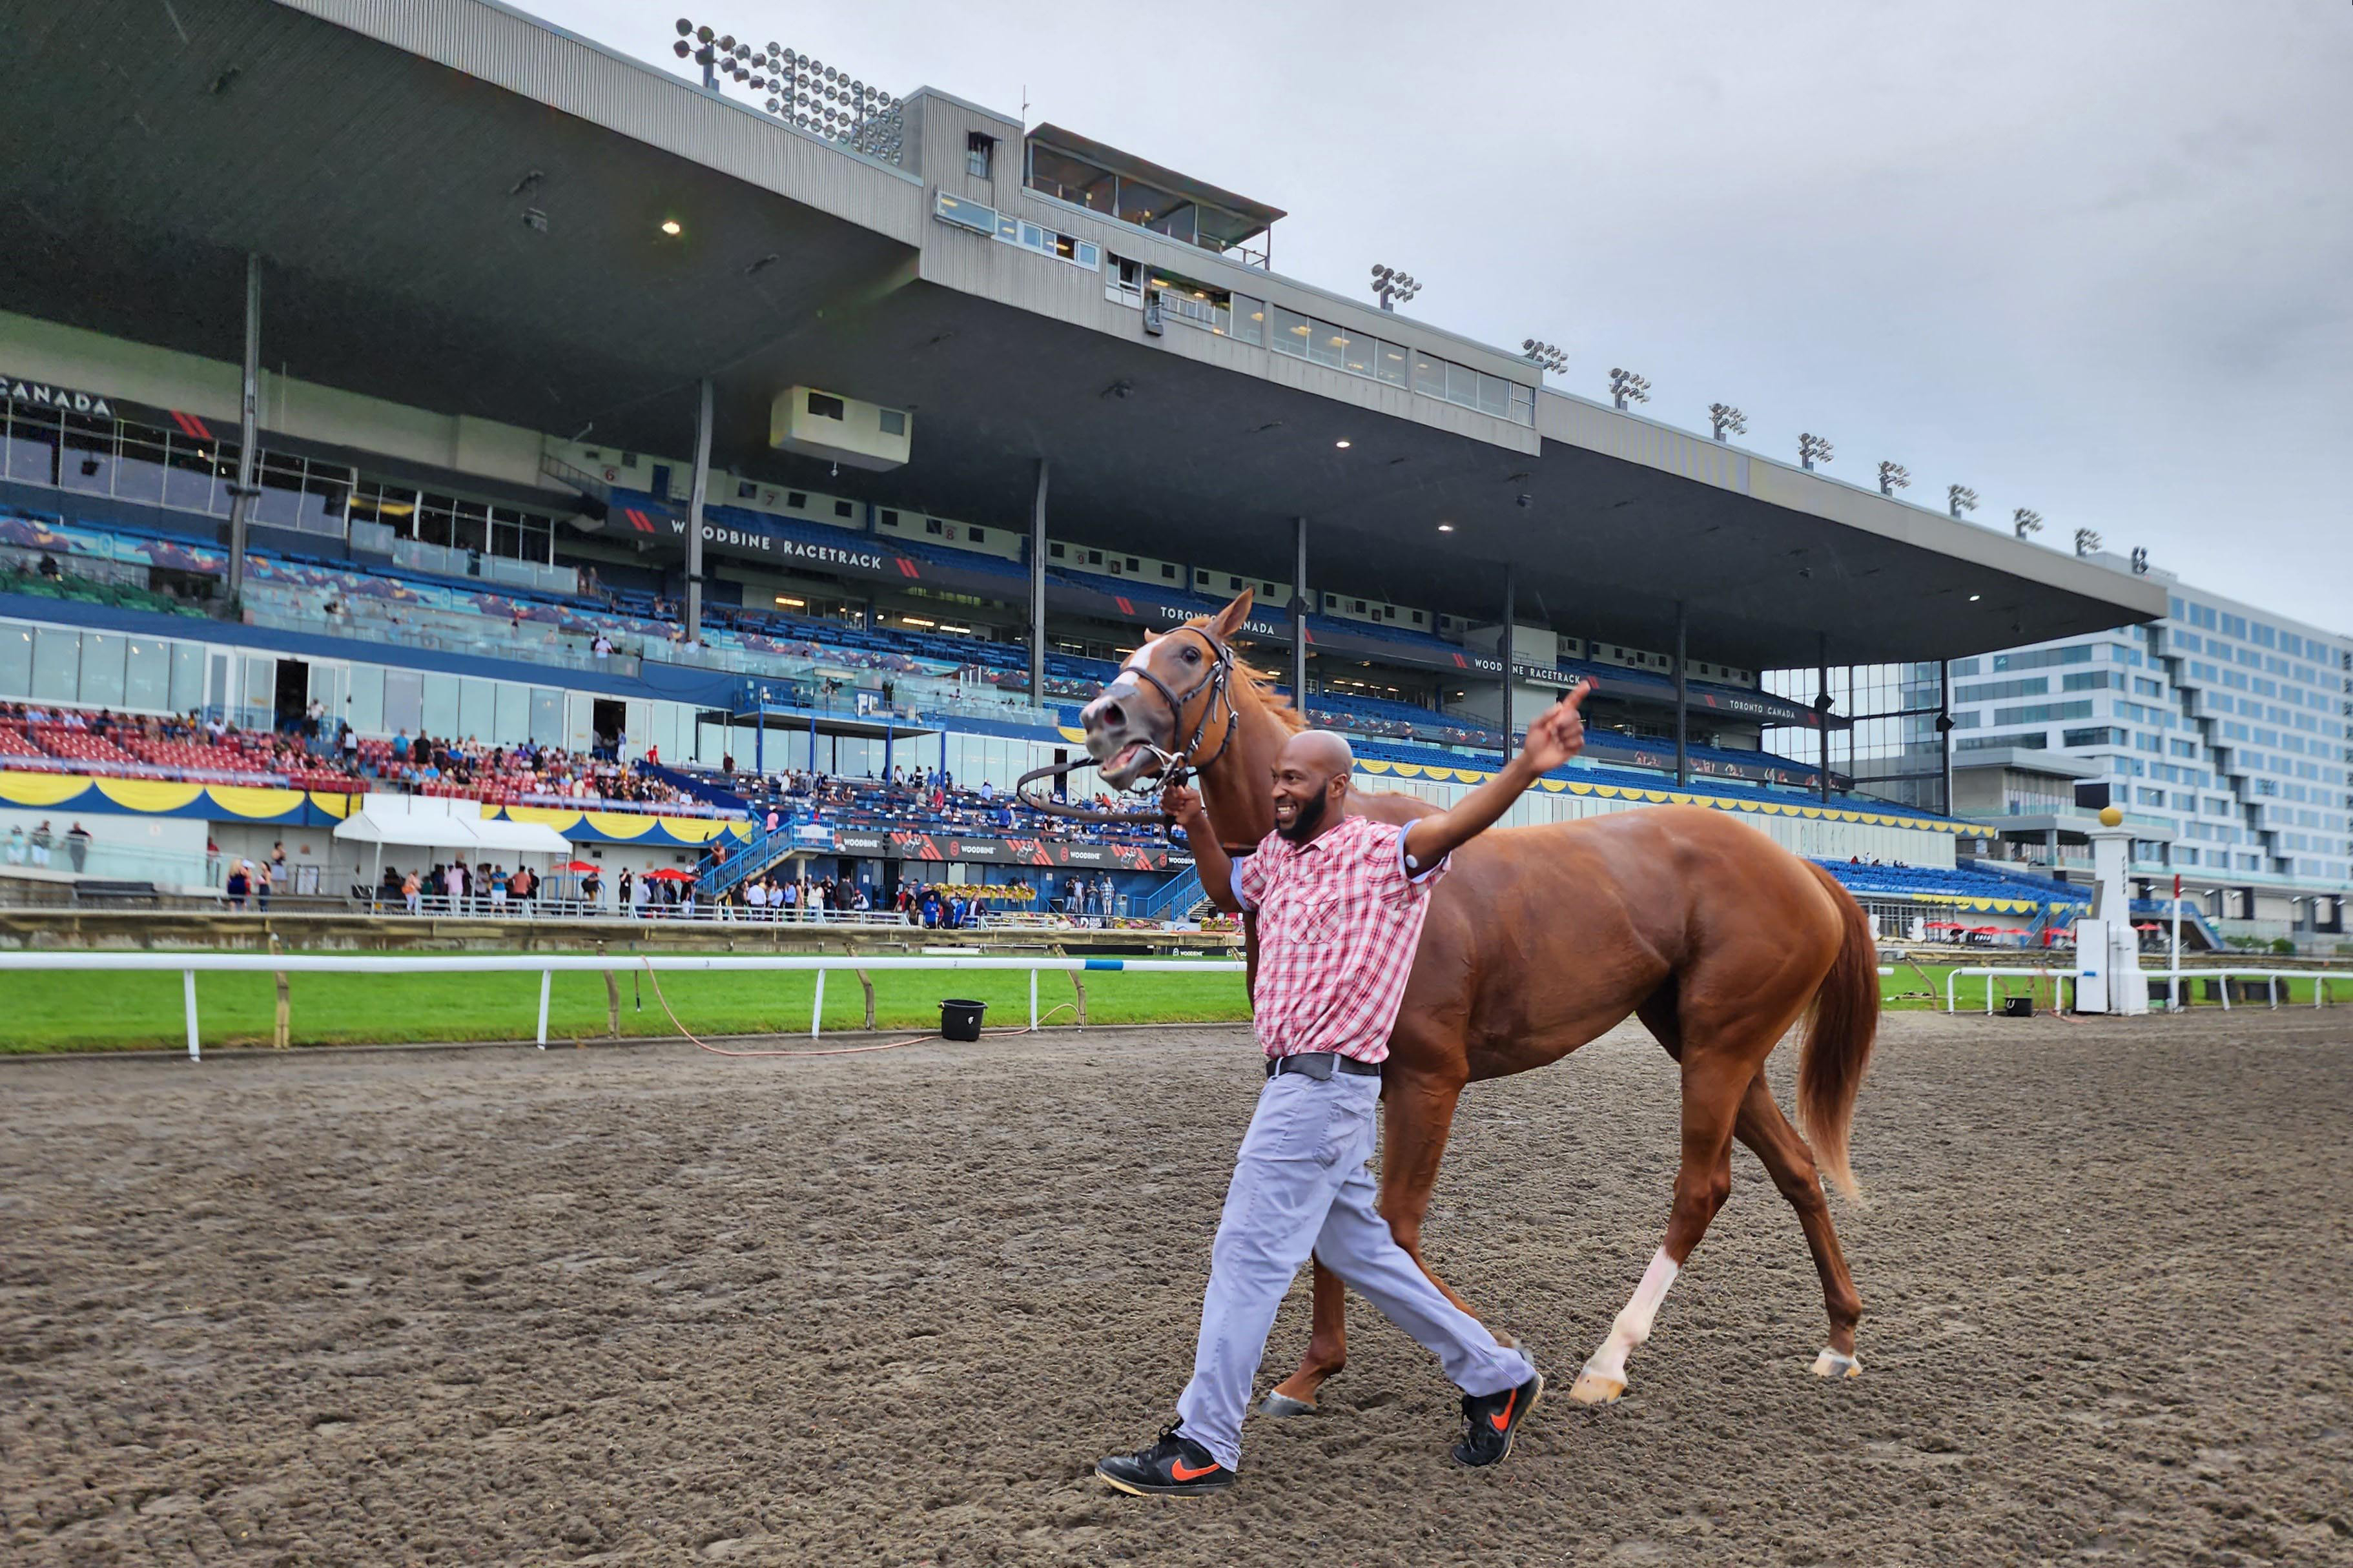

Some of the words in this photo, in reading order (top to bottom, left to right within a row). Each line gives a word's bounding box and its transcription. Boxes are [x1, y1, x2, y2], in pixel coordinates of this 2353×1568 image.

[766, 494, 776, 507] 7
[671, 519, 770, 551] WODBINE
[783, 540, 882, 569] RACETRACK
[1239, 620, 1275, 635] NADA
[1474, 658, 1524, 675] WOODNE
[1530, 667, 1580, 684] RACETRACK
[1730, 700, 1763, 713] TORONTO
[1767, 707, 1795, 719] CANADA
[843, 838, 878, 848] WOODBINE
[961, 845, 994, 855] WOODBINE
[1070, 851, 1100, 860] WOODBINE
